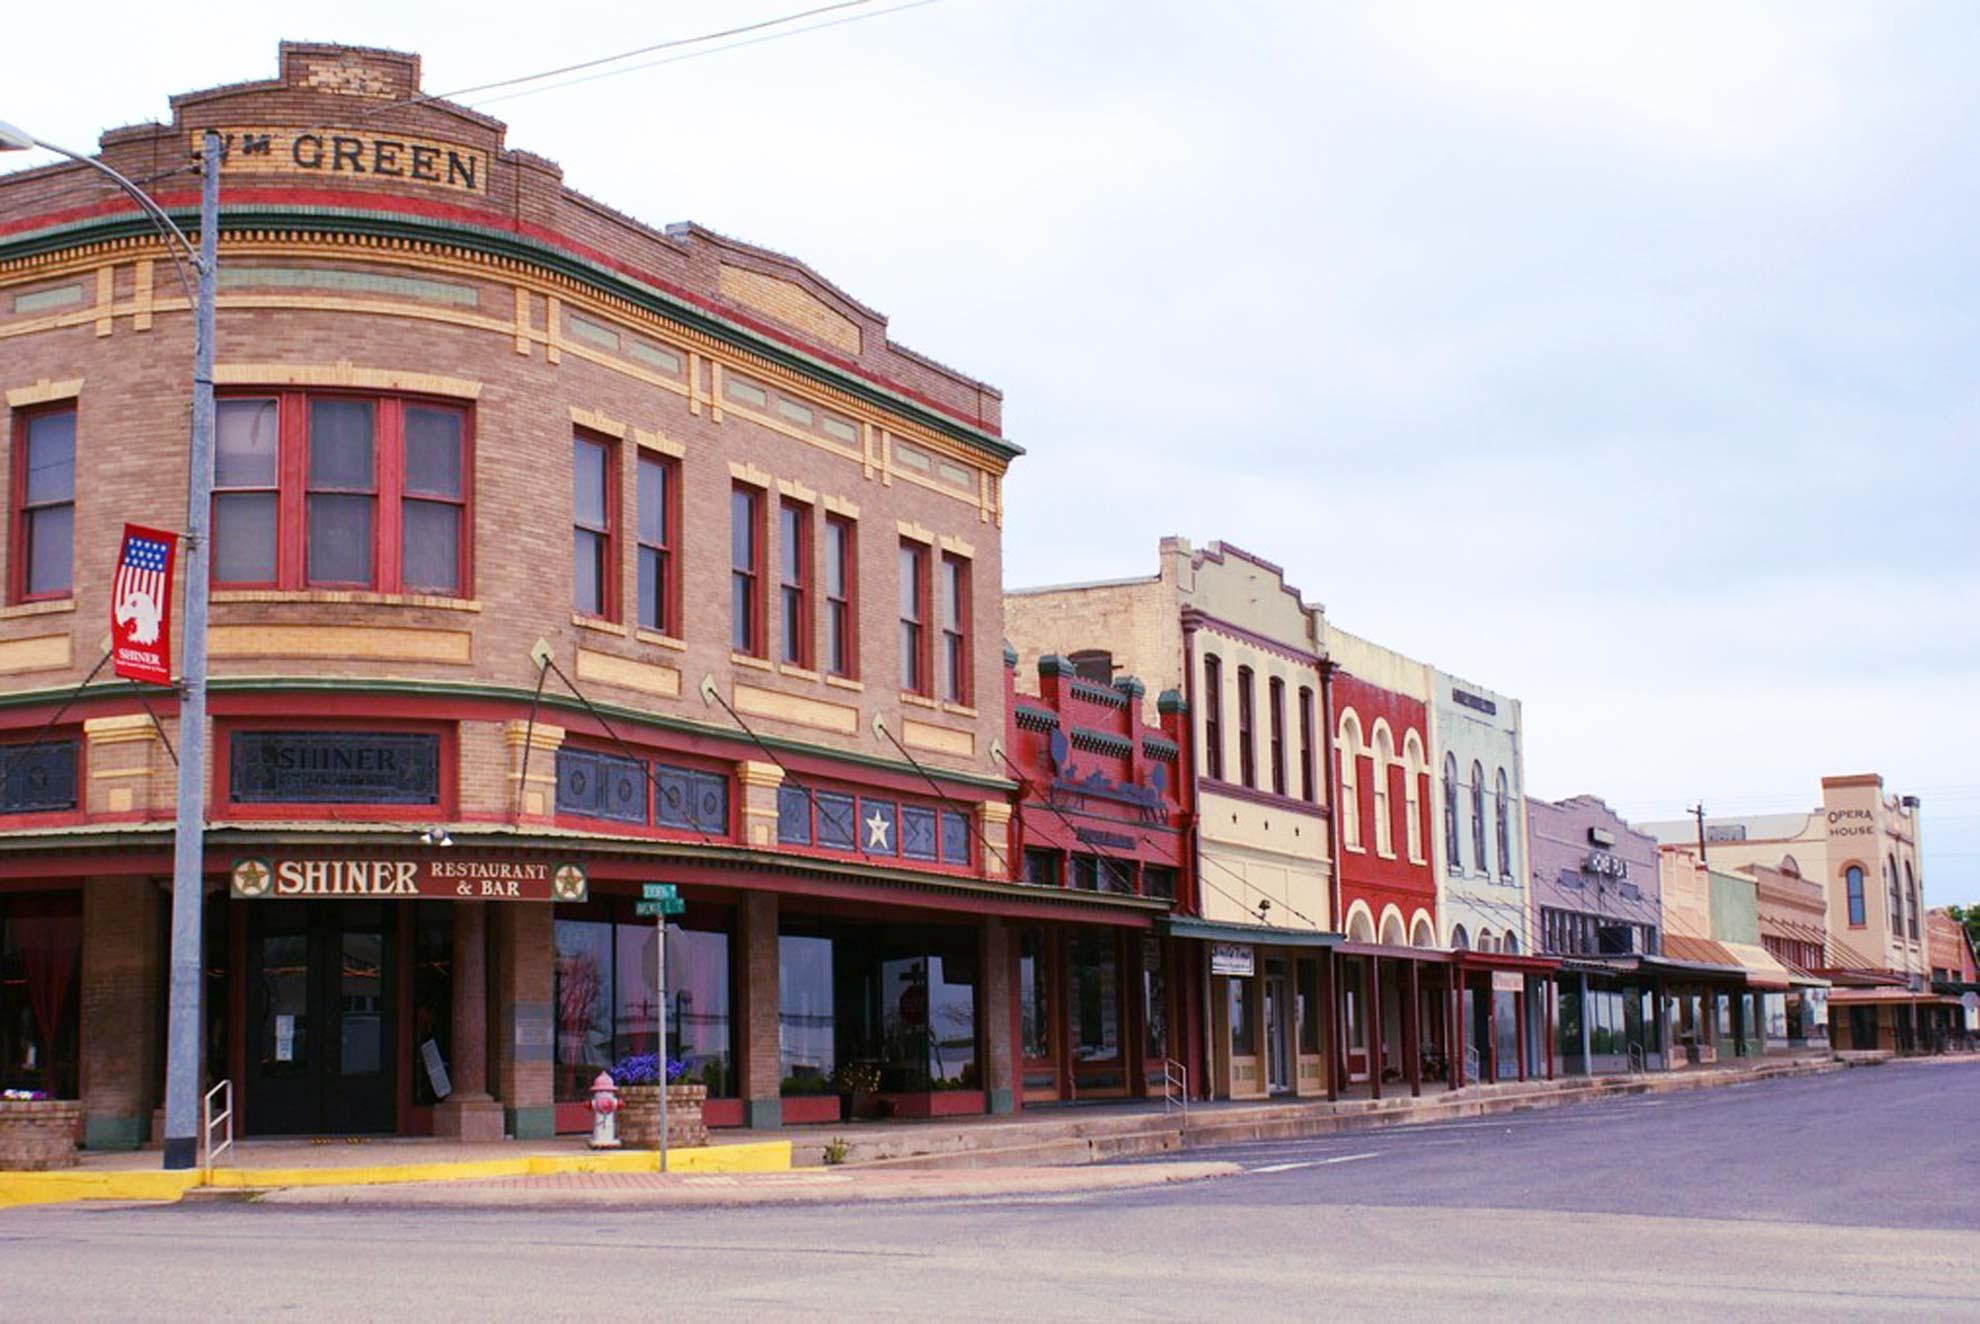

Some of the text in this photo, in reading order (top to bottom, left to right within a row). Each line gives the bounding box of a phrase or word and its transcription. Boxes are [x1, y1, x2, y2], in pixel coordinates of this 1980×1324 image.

[293, 134, 477, 189] GREEN
[118, 648, 160, 666] SHINER
[275, 747, 397, 771] SHINER
[1828, 809, 1873, 824] OPERA
[1829, 826, 1874, 837] HOUSE
[278, 860, 549, 894] SHINER RESTAURANT
[456, 880, 520, 896] & BAR
